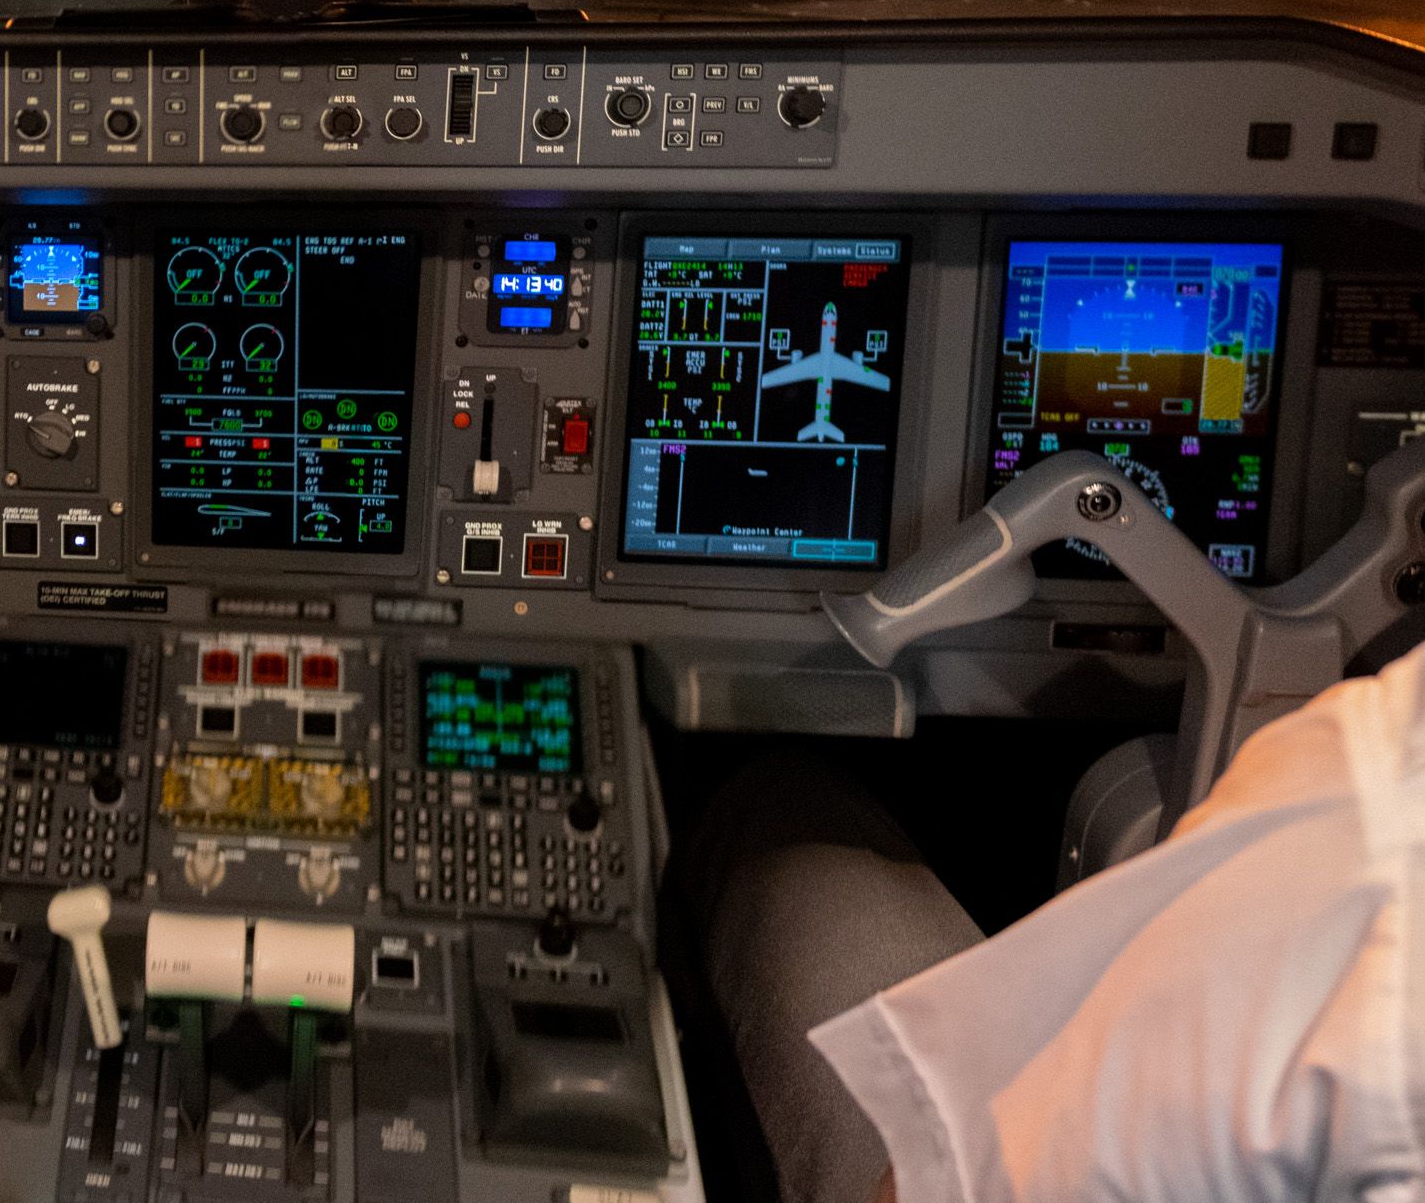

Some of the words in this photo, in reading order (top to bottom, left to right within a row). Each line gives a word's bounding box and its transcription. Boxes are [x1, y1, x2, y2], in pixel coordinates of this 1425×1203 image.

[340, 68, 353, 77] ALT
[400, 68, 413, 77] FPA
[493, 68, 502, 77] VS
[333, 95, 344, 104] ALT
[345, 95, 357, 104] SEL
[393, 95, 404, 104] FPA
[405, 95, 417, 104] SEL
[705, 101, 722, 110] PREV
[331, 245, 346, 255] OFF
[678, 244, 695, 255] Map
[760, 245, 782, 255] Plan
[816, 245, 853, 257] Systems
[643, 260, 672, 270] FLIGHT
[186, 268, 204, 279] OFF
[253, 269, 272, 280] OFF
[698, 270, 714, 279] SAT
[544, 276, 563, 292] 40
[191, 293, 209, 303] 0.0
[258, 294, 277, 304] 0.0
[458, 379, 470, 387] DN
[485, 374, 497, 382] UP
[26, 383, 79, 394] AUTOBRAKE
[452, 390, 474, 399] LOCK
[45, 398, 59, 407] OFF
[455, 400, 470, 409] REL
[14, 412, 29, 420] RTO
[662, 444, 687, 455] FMS2
[350, 457, 366, 466] 400
[373, 458, 385, 467] FT
[373, 468, 389, 478] FPM
[349, 478, 365, 487] 0.0
[372, 478, 388, 488] PSI
[311, 502, 331, 512] ROLL
[361, 498, 386, 508] PITCH
[376, 512, 387, 521] UP
[465, 521, 481, 530] GND
[481, 522, 503, 531] PROX
[544, 519, 562, 528] WRN
[731, 526, 772, 538] Waypoint
[773, 527, 804, 537] Center
[69, 587, 88, 596] MAX
[90, 588, 131, 598] TAKE-OFF
[132, 590, 166, 599] THRUST
[62, 596, 107, 606] CERTIFIED
